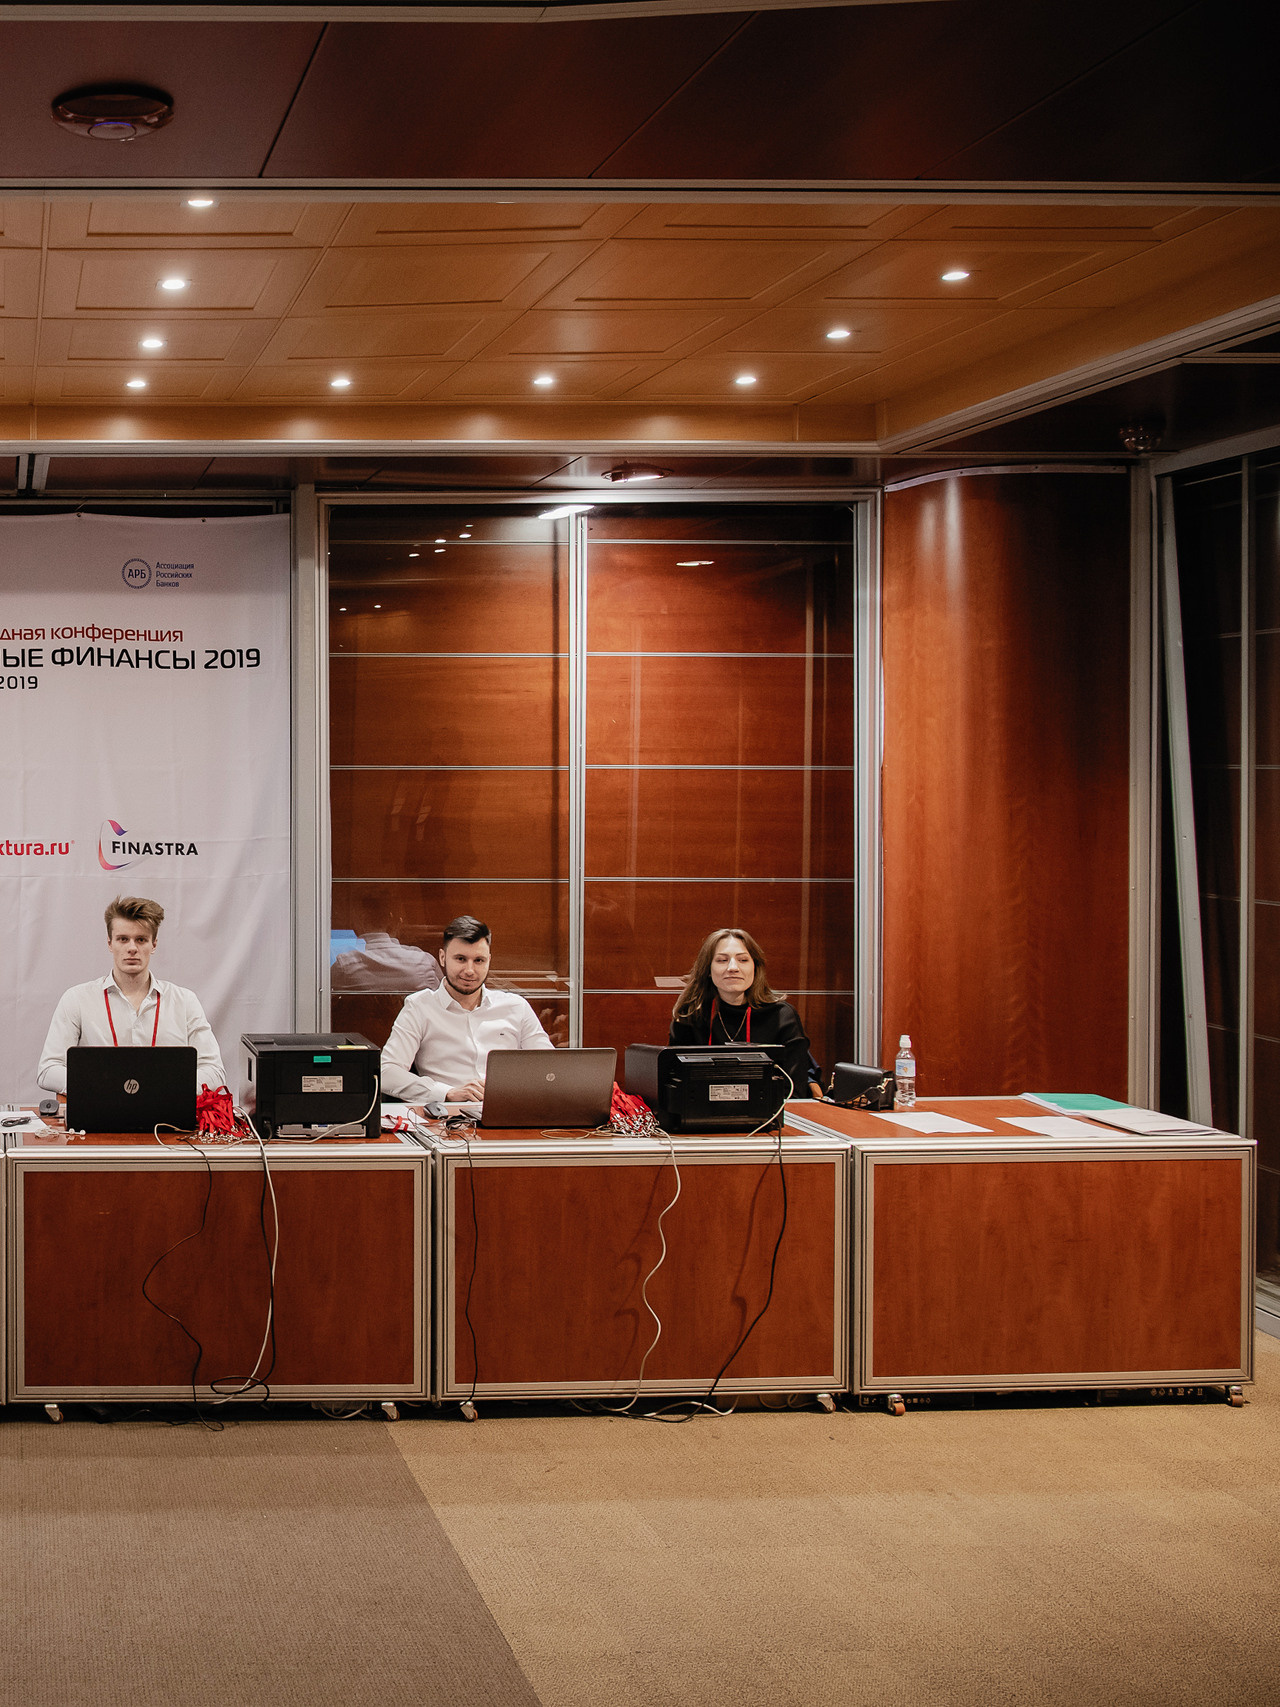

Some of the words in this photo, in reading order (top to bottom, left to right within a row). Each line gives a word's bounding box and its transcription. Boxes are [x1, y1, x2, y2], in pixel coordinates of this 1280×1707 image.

[155, 561, 195, 570] Ассоциация
[127, 568, 147, 579] АРБ
[155, 570, 193, 579] Российских
[155, 580, 180, 588] Банков
[50, 623, 184, 644] конференция
[51, 646, 196, 670] ФИНАНСЫ
[203, 648, 261, 670] 2019
[111, 840, 198, 856] FINASTRA
